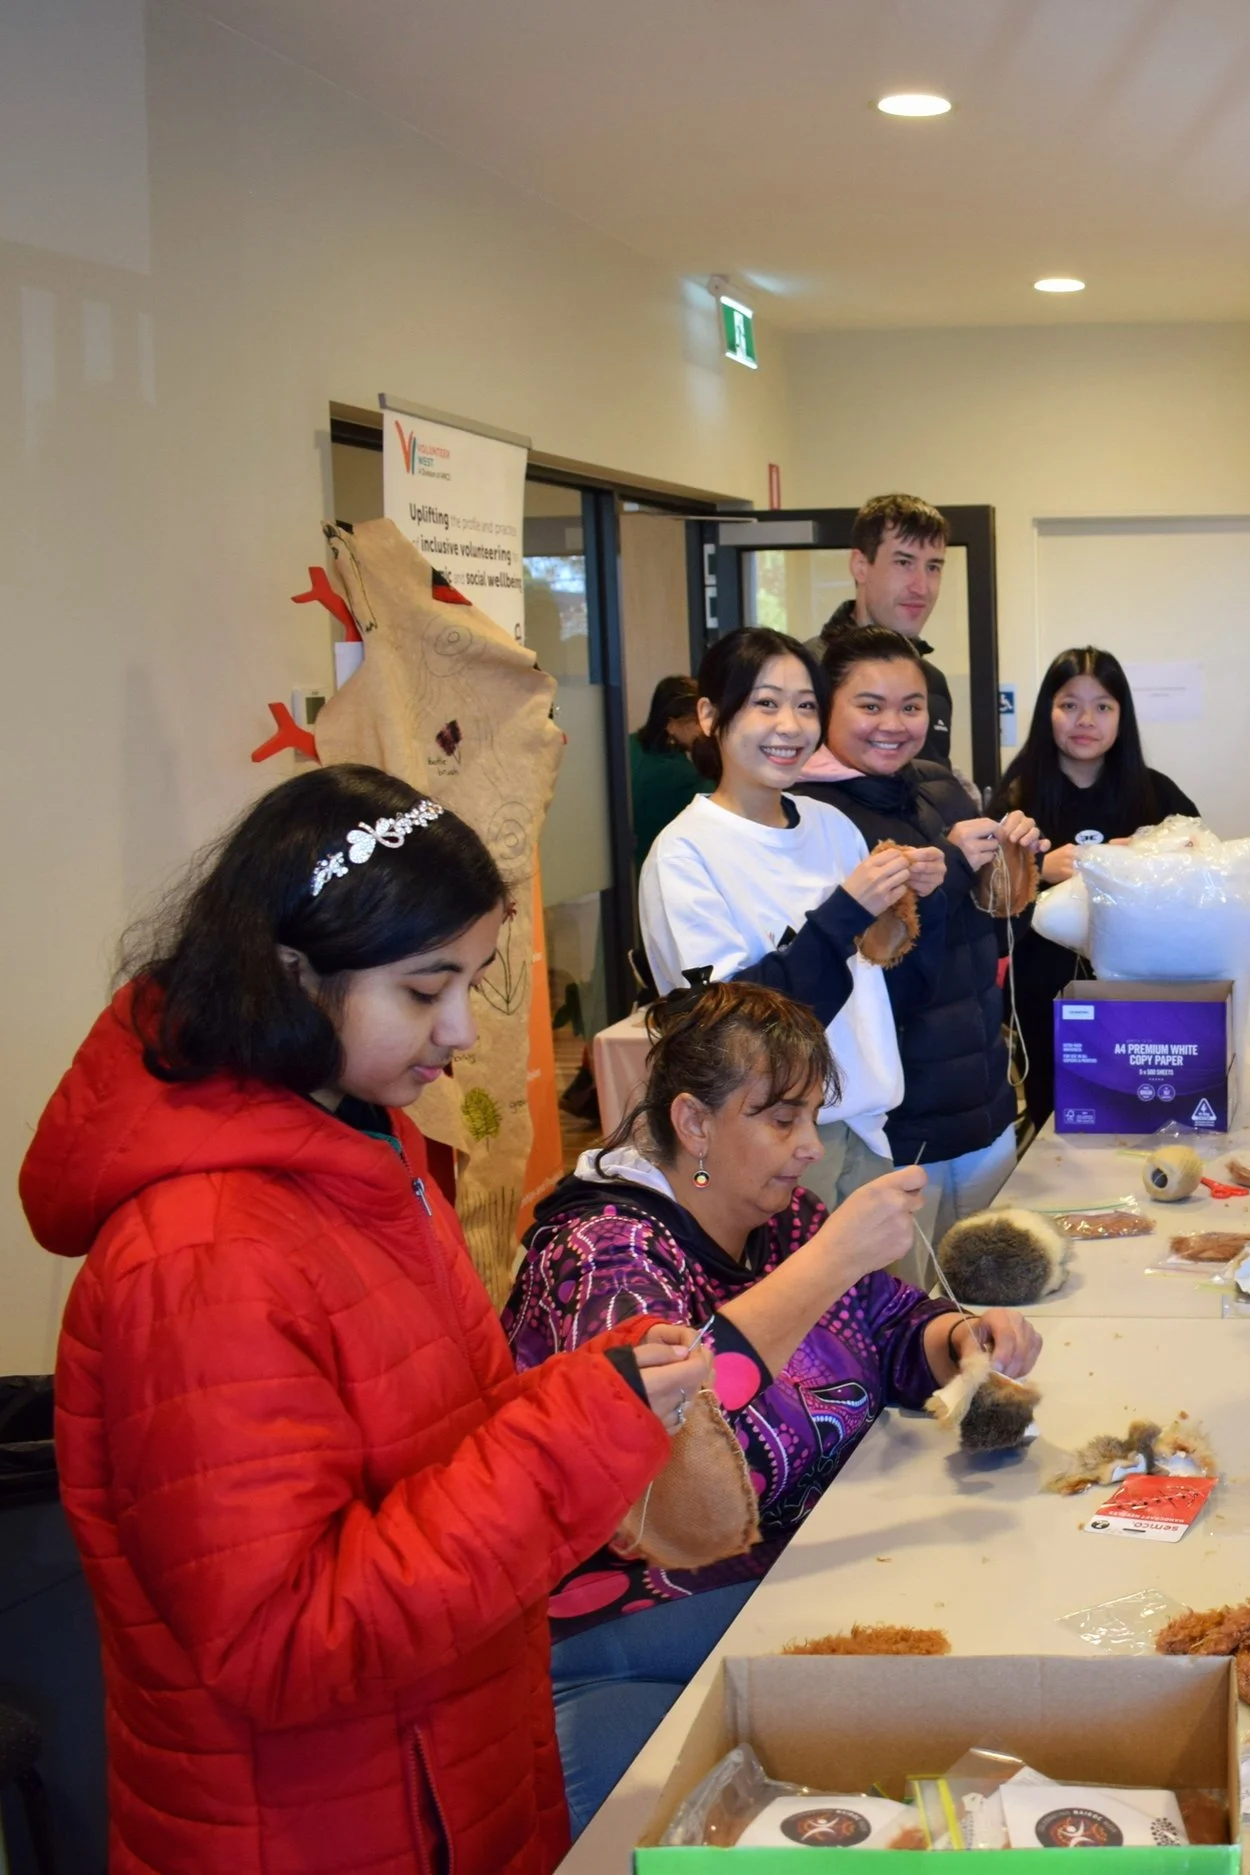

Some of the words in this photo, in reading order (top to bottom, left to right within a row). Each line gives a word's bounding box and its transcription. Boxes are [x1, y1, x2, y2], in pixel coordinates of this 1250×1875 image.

[418, 444, 450, 460] VOLUNTEER
[418, 457, 434, 467] WEST
[409, 502, 449, 530] Uplifting
[421, 534, 459, 555] inclusive
[460, 541, 511, 566] volunteering
[466, 569, 487, 587] social
[488, 572, 523, 593] wellbeing
[1114, 1043, 1126, 1054] A4
[1128, 1043, 1169, 1054] PREMIUM
[1170, 1044, 1198, 1056] WHITE
[1129, 1055, 1153, 1066] COPY
[1154, 1055, 1184, 1066] PAPER
[1134, 1521, 1179, 1532] semco
